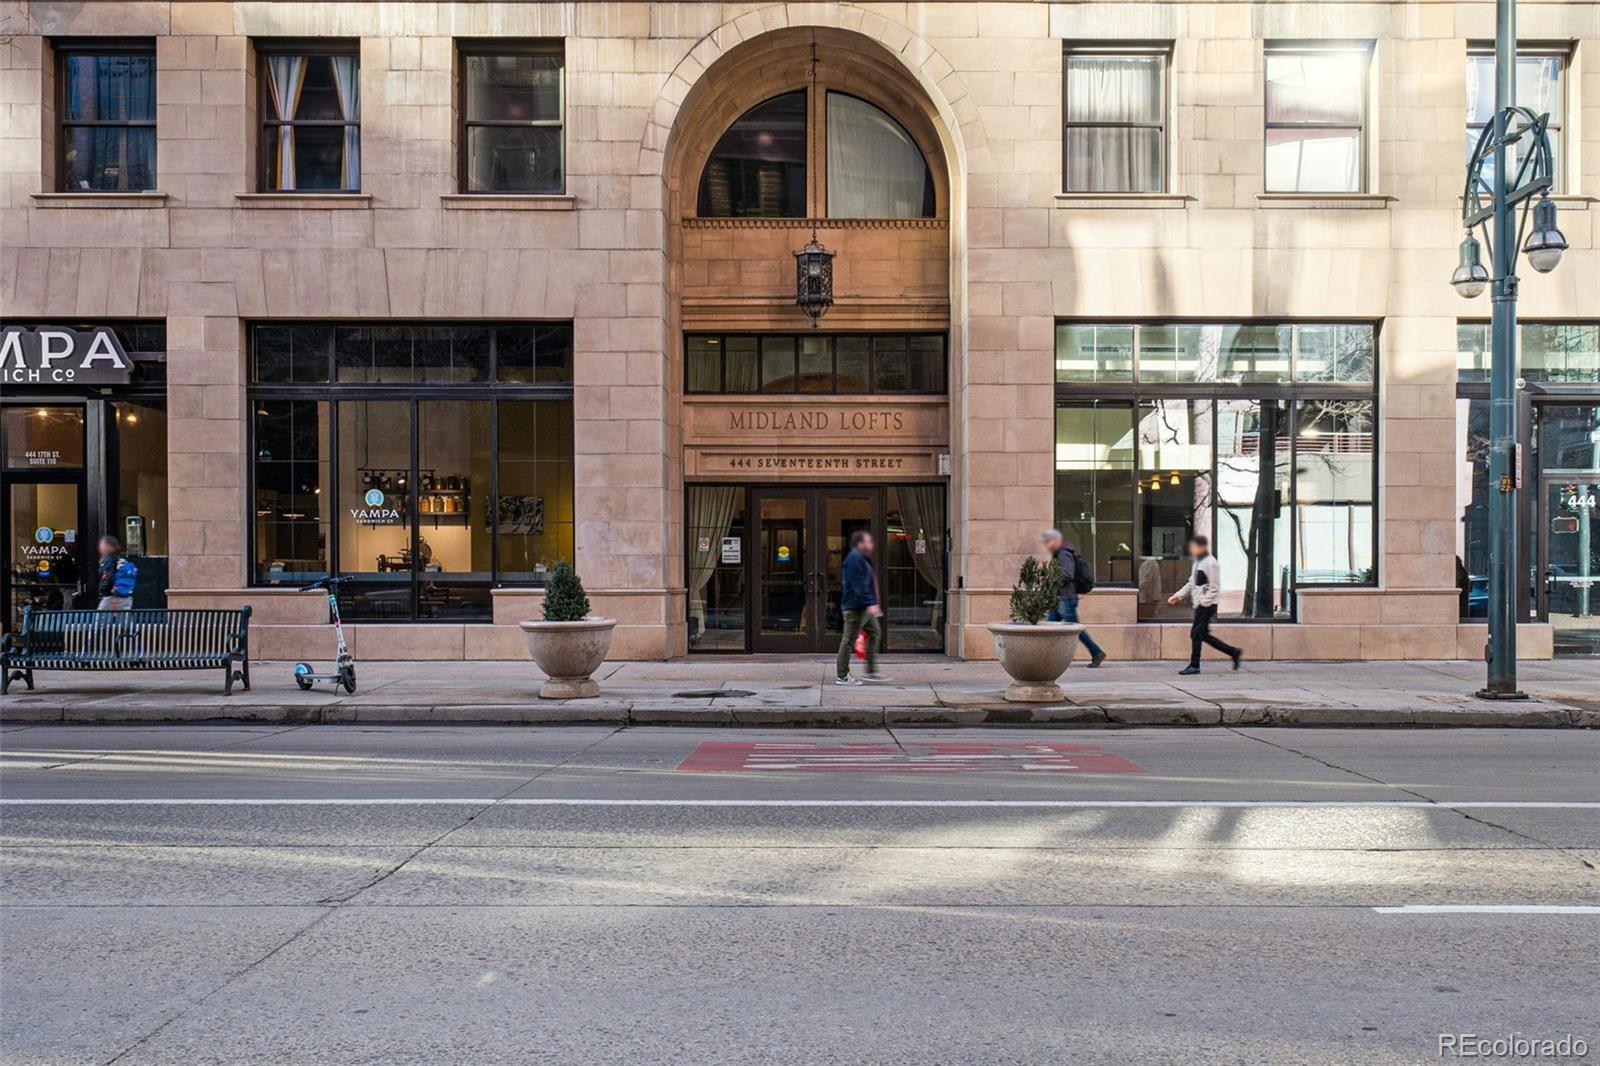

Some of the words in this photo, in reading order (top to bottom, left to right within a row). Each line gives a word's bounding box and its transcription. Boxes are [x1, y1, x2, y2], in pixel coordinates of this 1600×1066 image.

[4, 369, 40, 382] ICH
[730, 411, 829, 430] MIDLAND
[840, 411, 903, 430] LOFTS
[729, 458, 752, 468] 444
[757, 458, 849, 468] SEVENTEENTH
[855, 458, 903, 468] STREET
[1567, 495, 1596, 508] 444
[350, 509, 400, 518] YAMPA
[21, 545, 68, 554] YAMPA
